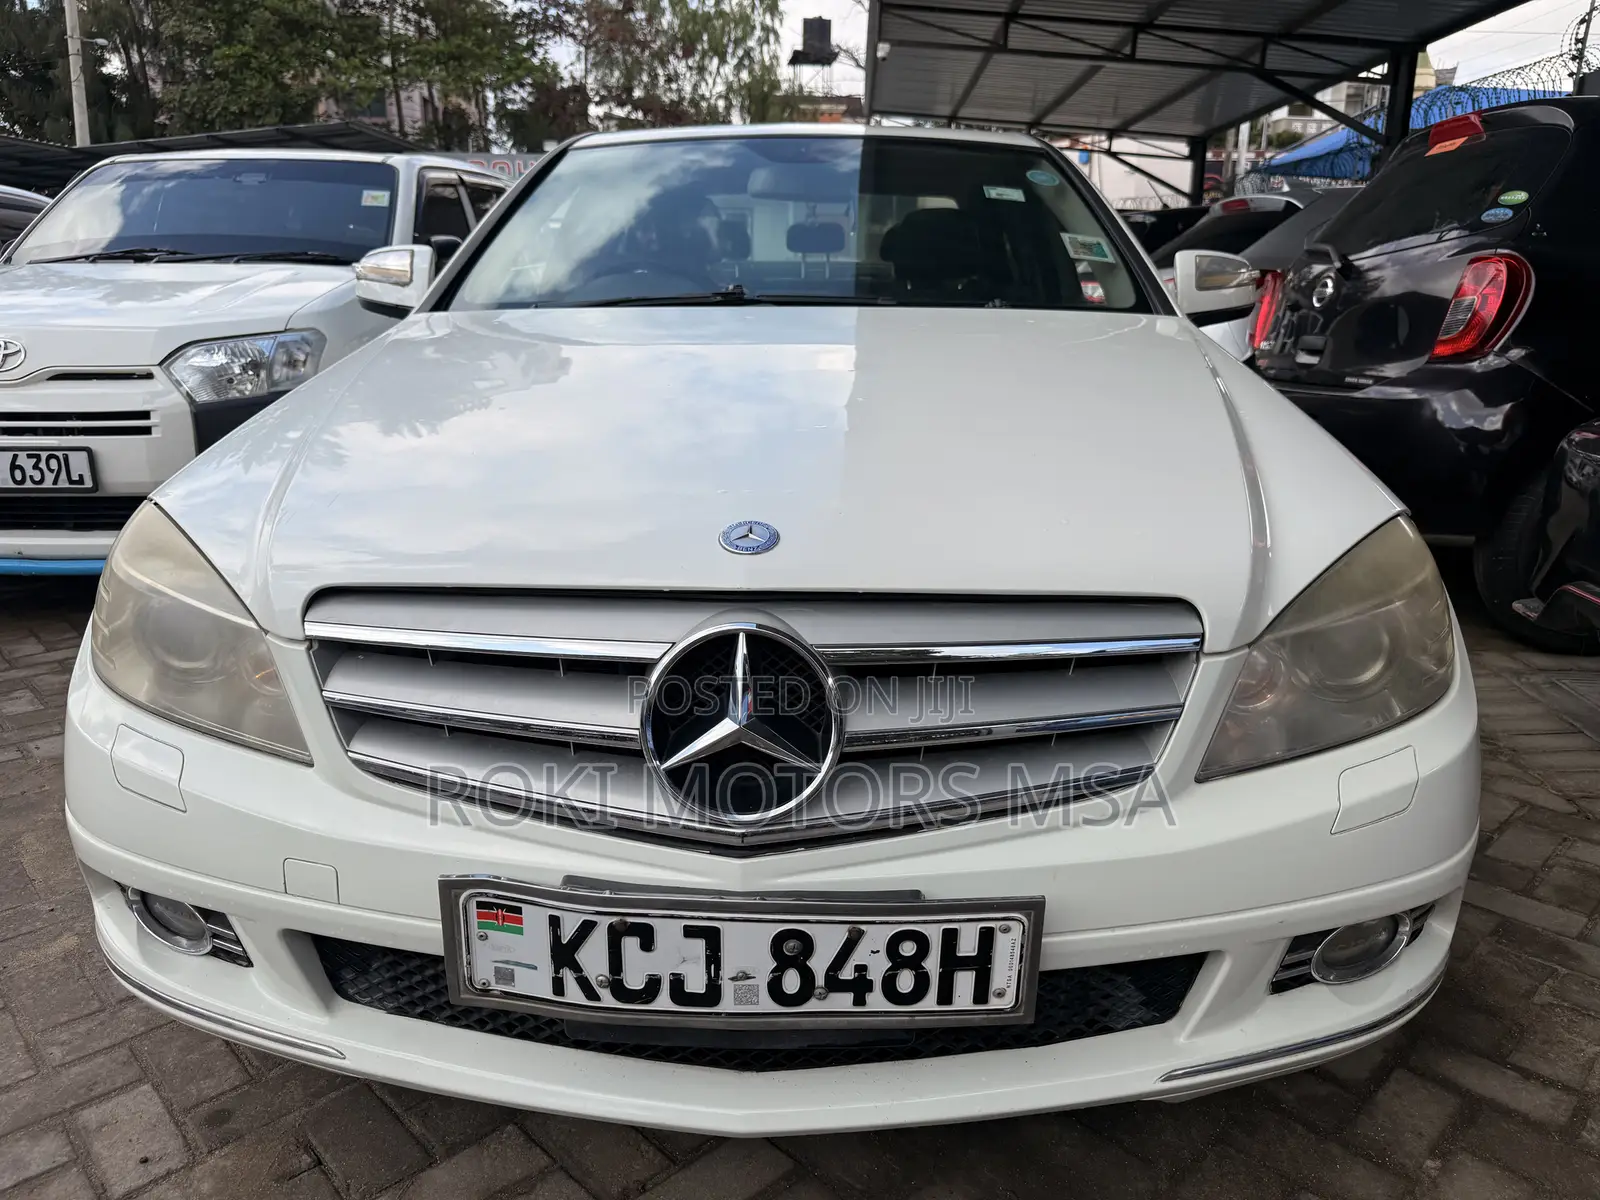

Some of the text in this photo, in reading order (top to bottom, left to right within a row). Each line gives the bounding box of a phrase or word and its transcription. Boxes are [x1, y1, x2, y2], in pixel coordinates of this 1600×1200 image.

[9, 453, 85, 486] 639L
[548, 913, 996, 1008] KCJ 848H
